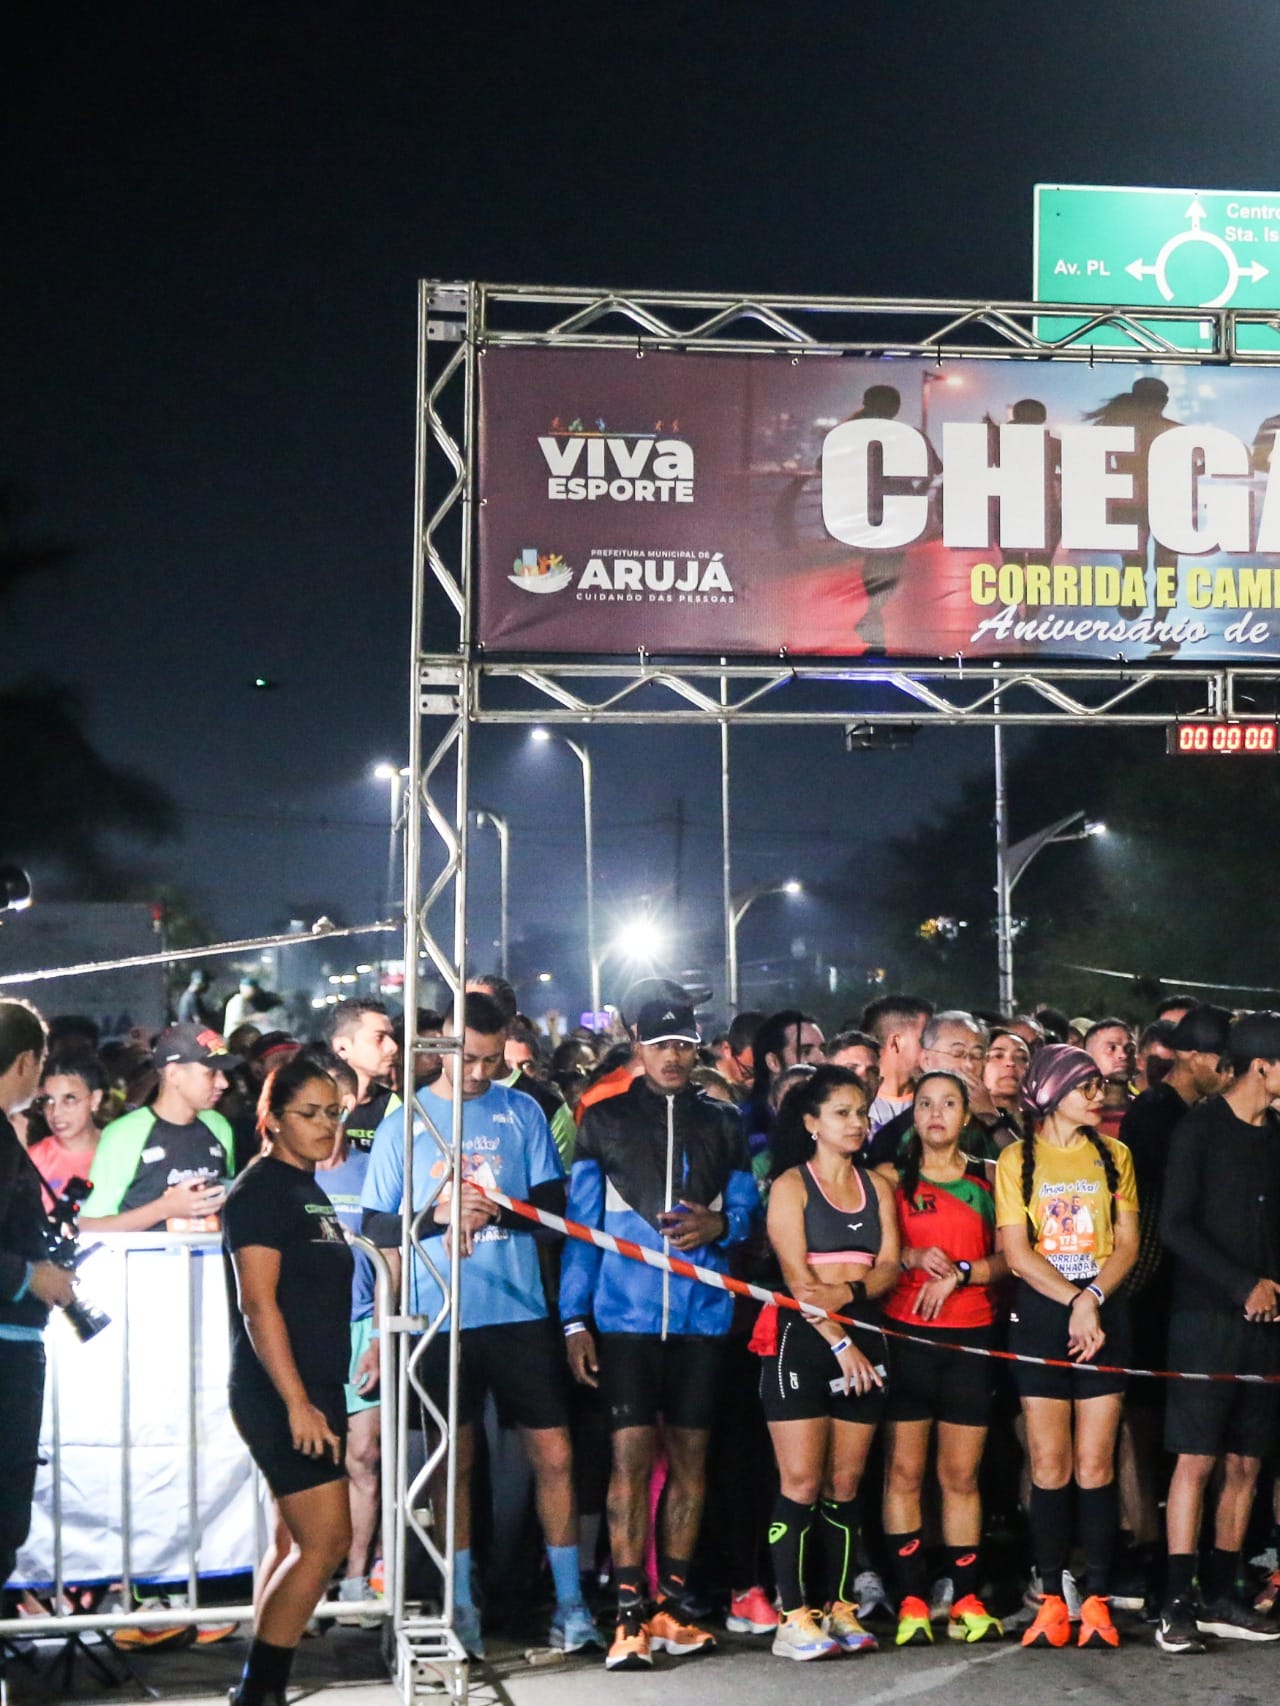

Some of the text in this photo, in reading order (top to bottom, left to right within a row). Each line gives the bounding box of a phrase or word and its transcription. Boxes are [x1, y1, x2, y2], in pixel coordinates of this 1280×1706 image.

[1224, 225, 1259, 242] Sta.
[1053, 259, 1111, 277] Av. PL
[548, 477, 695, 503] ESPORTE
[590, 549, 711, 560] PREFEITURA MUNICIPAL DE
[577, 551, 734, 592] ARUJÁ
[970, 563, 1148, 608] CORRIDA
[1156, 566, 1178, 608] E
[576, 592, 735, 604] CUIDANDO DAS PESSOAS
[970, 604, 1209, 644] Aniversário
[1223, 611, 1270, 644] de
[1180, 727, 1274, 750] 00 00 00
